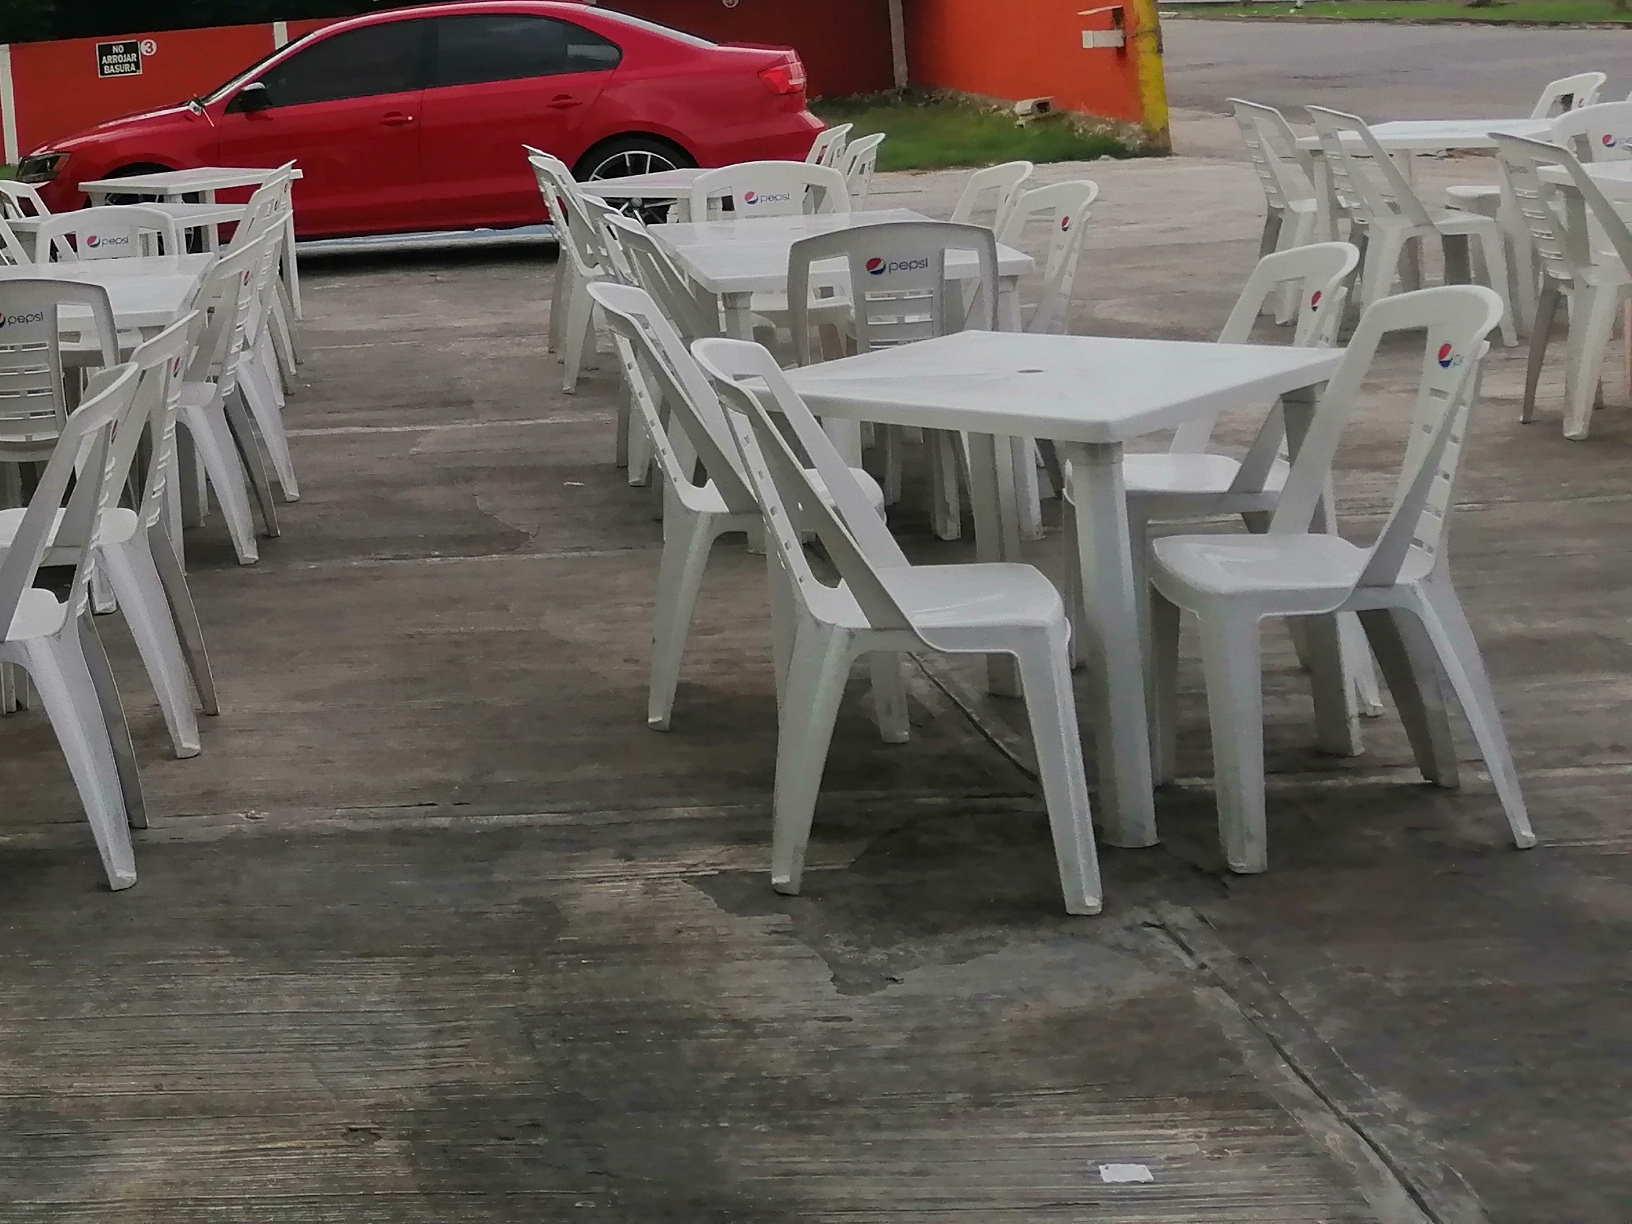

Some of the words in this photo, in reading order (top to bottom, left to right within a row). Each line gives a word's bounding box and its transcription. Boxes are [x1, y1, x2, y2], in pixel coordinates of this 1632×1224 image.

[112, 44, 125, 54] NO
[144, 40, 154, 54] 3
[101, 53, 137, 65] ARROJAR
[103, 63, 136, 74] BASURA
[760, 192, 790, 204] pepsi
[101, 235, 129, 247] pepsi
[888, 257, 929, 273] pepsi
[8, 310, 44, 326] pepsi
